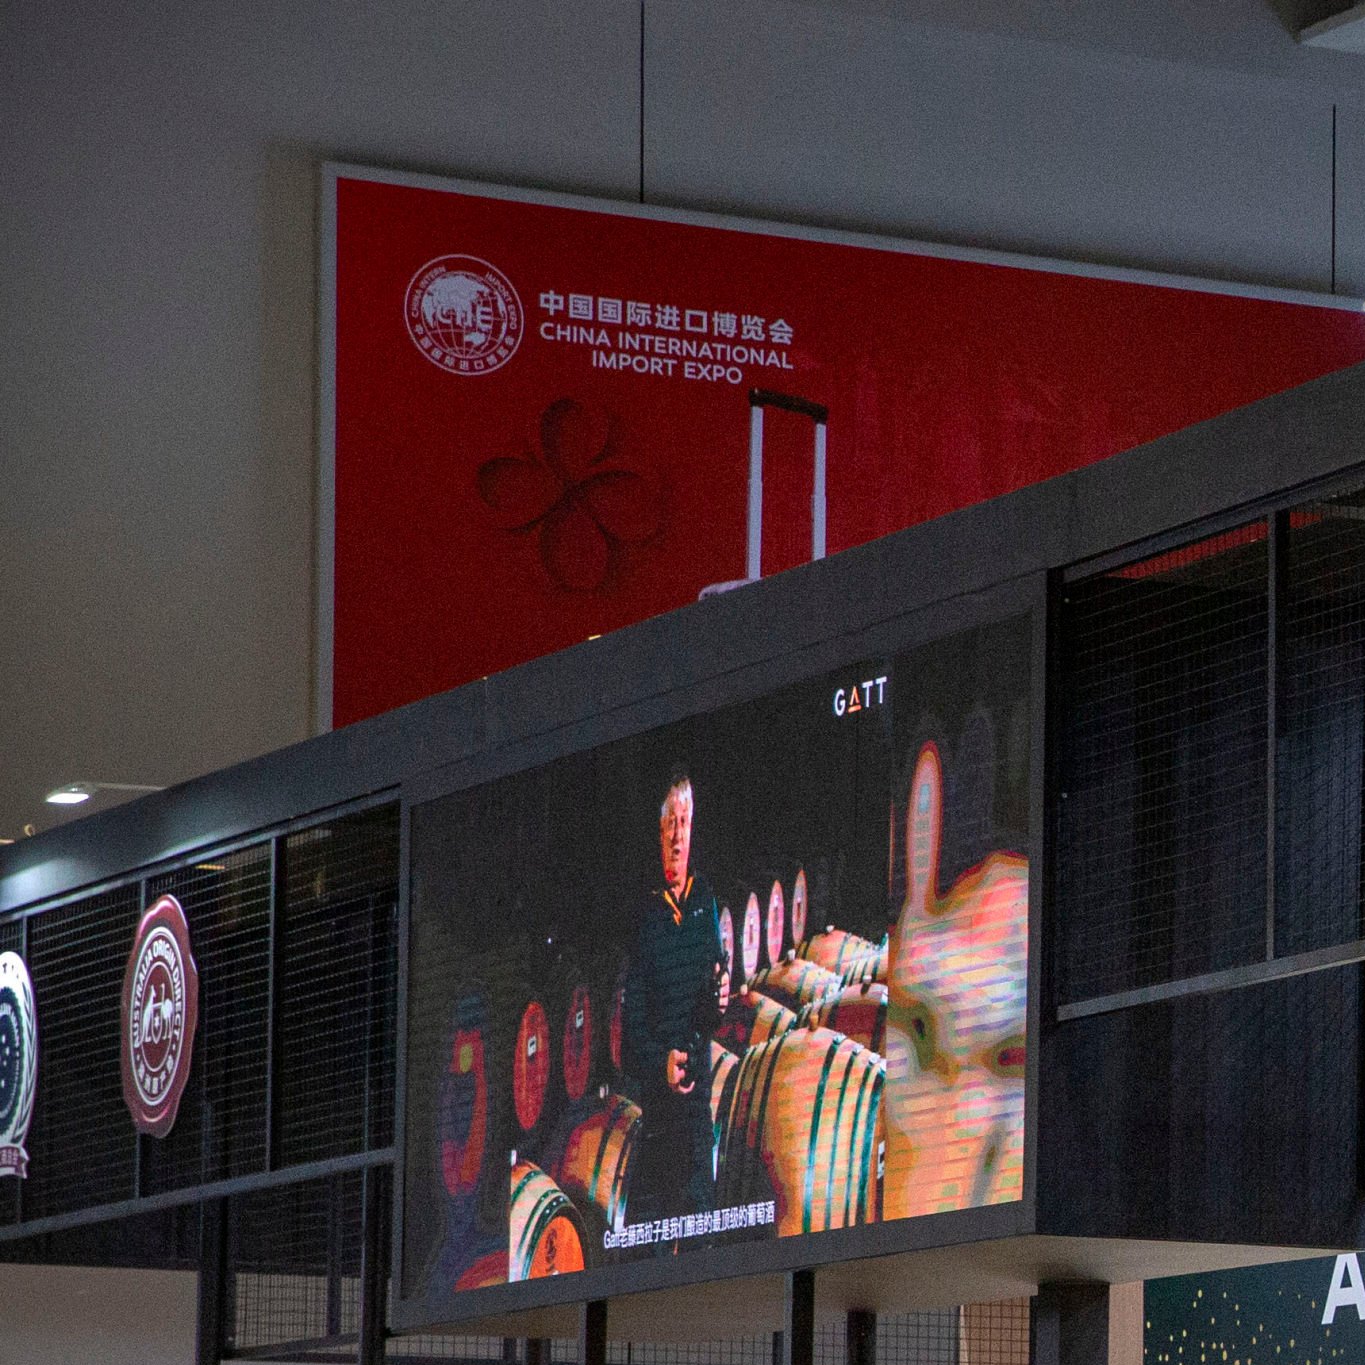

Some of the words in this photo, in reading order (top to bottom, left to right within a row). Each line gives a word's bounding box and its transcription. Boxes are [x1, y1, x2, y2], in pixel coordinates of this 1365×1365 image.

[538, 289, 794, 346] 中国国际进口博览会
[539, 321, 612, 348] CHINA
[617, 332, 794, 371] INTERNATIONAL
[592, 350, 682, 377] IMPORT
[683, 360, 743, 386] EXPO
